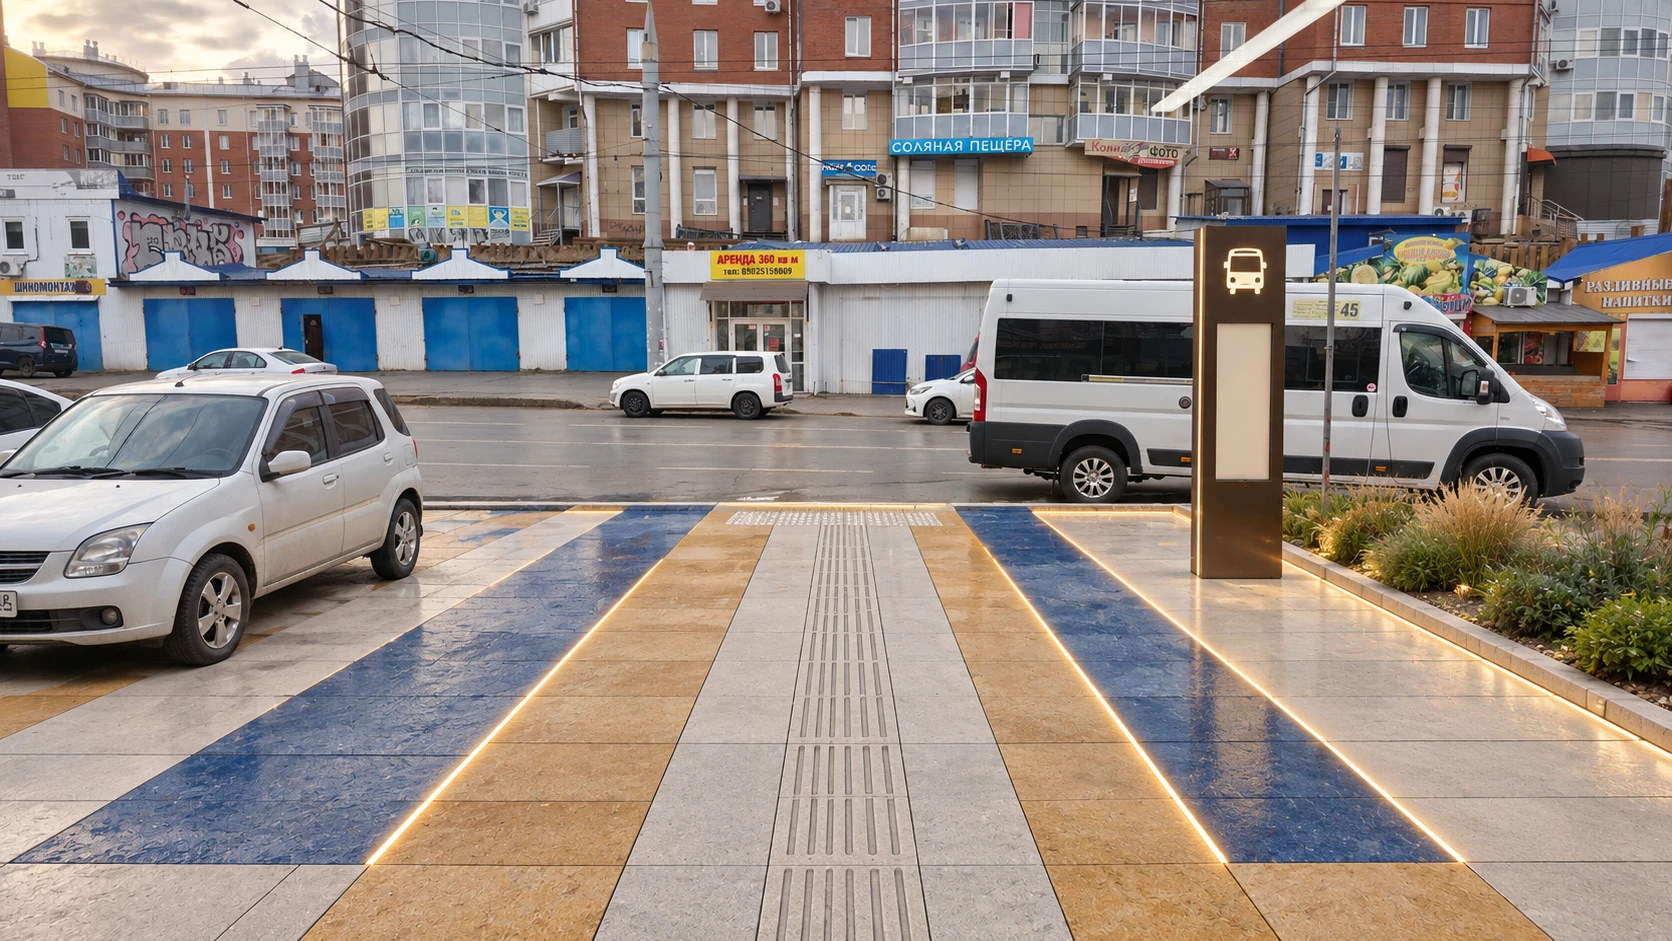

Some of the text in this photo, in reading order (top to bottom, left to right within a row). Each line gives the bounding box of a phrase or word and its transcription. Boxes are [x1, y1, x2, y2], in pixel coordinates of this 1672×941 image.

[892, 140, 964, 154] СОЛЯНАЯ
[717, 254, 756, 266] АРЕНДА
[758, 254, 775, 264] 360
[1585, 278, 1672, 293] РАЗЛИВНЫЕ
[1602, 295, 1672, 309] НАПИТКИ
[1339, 303, 1360, 317] 45
